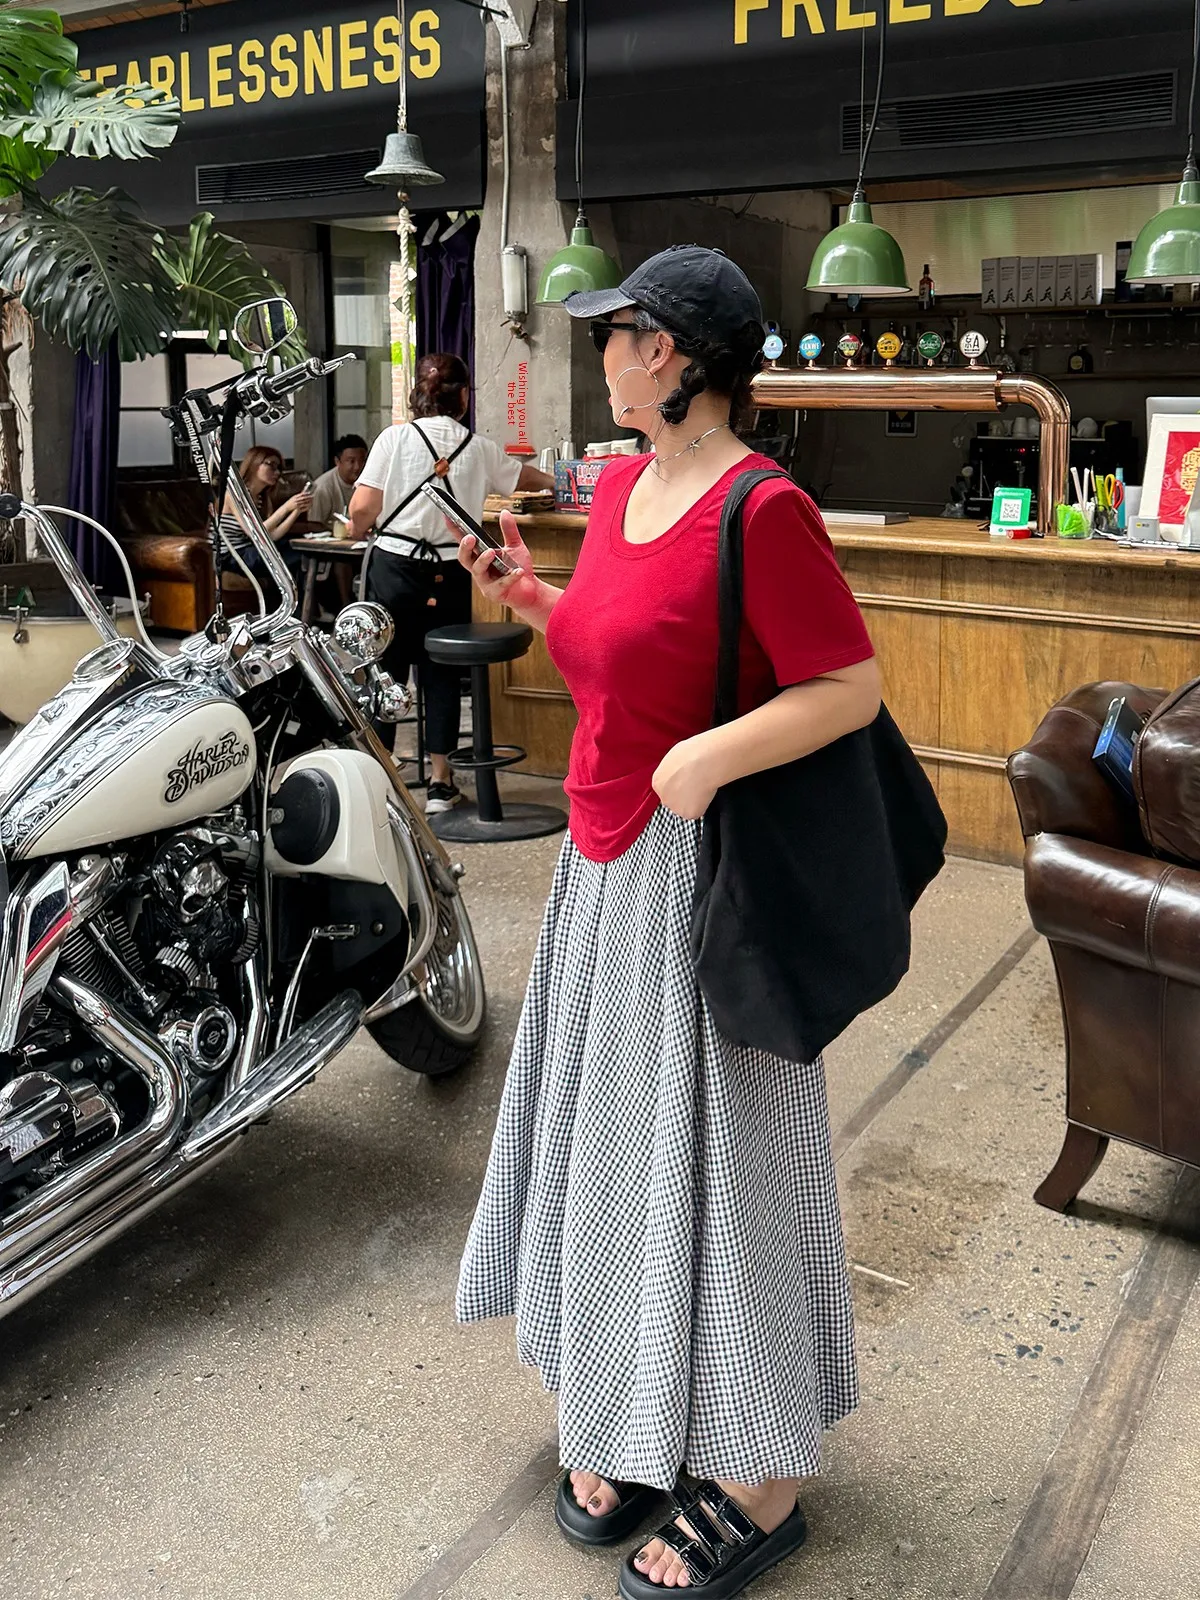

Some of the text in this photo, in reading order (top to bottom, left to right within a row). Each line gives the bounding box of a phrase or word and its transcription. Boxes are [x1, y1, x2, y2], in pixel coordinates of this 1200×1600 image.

[79, 9, 441, 113] ARLESSNESS
[181, 410, 210, 484] HARLEY-DAVIDSON
[164, 744, 250, 803] DAVIDSON
